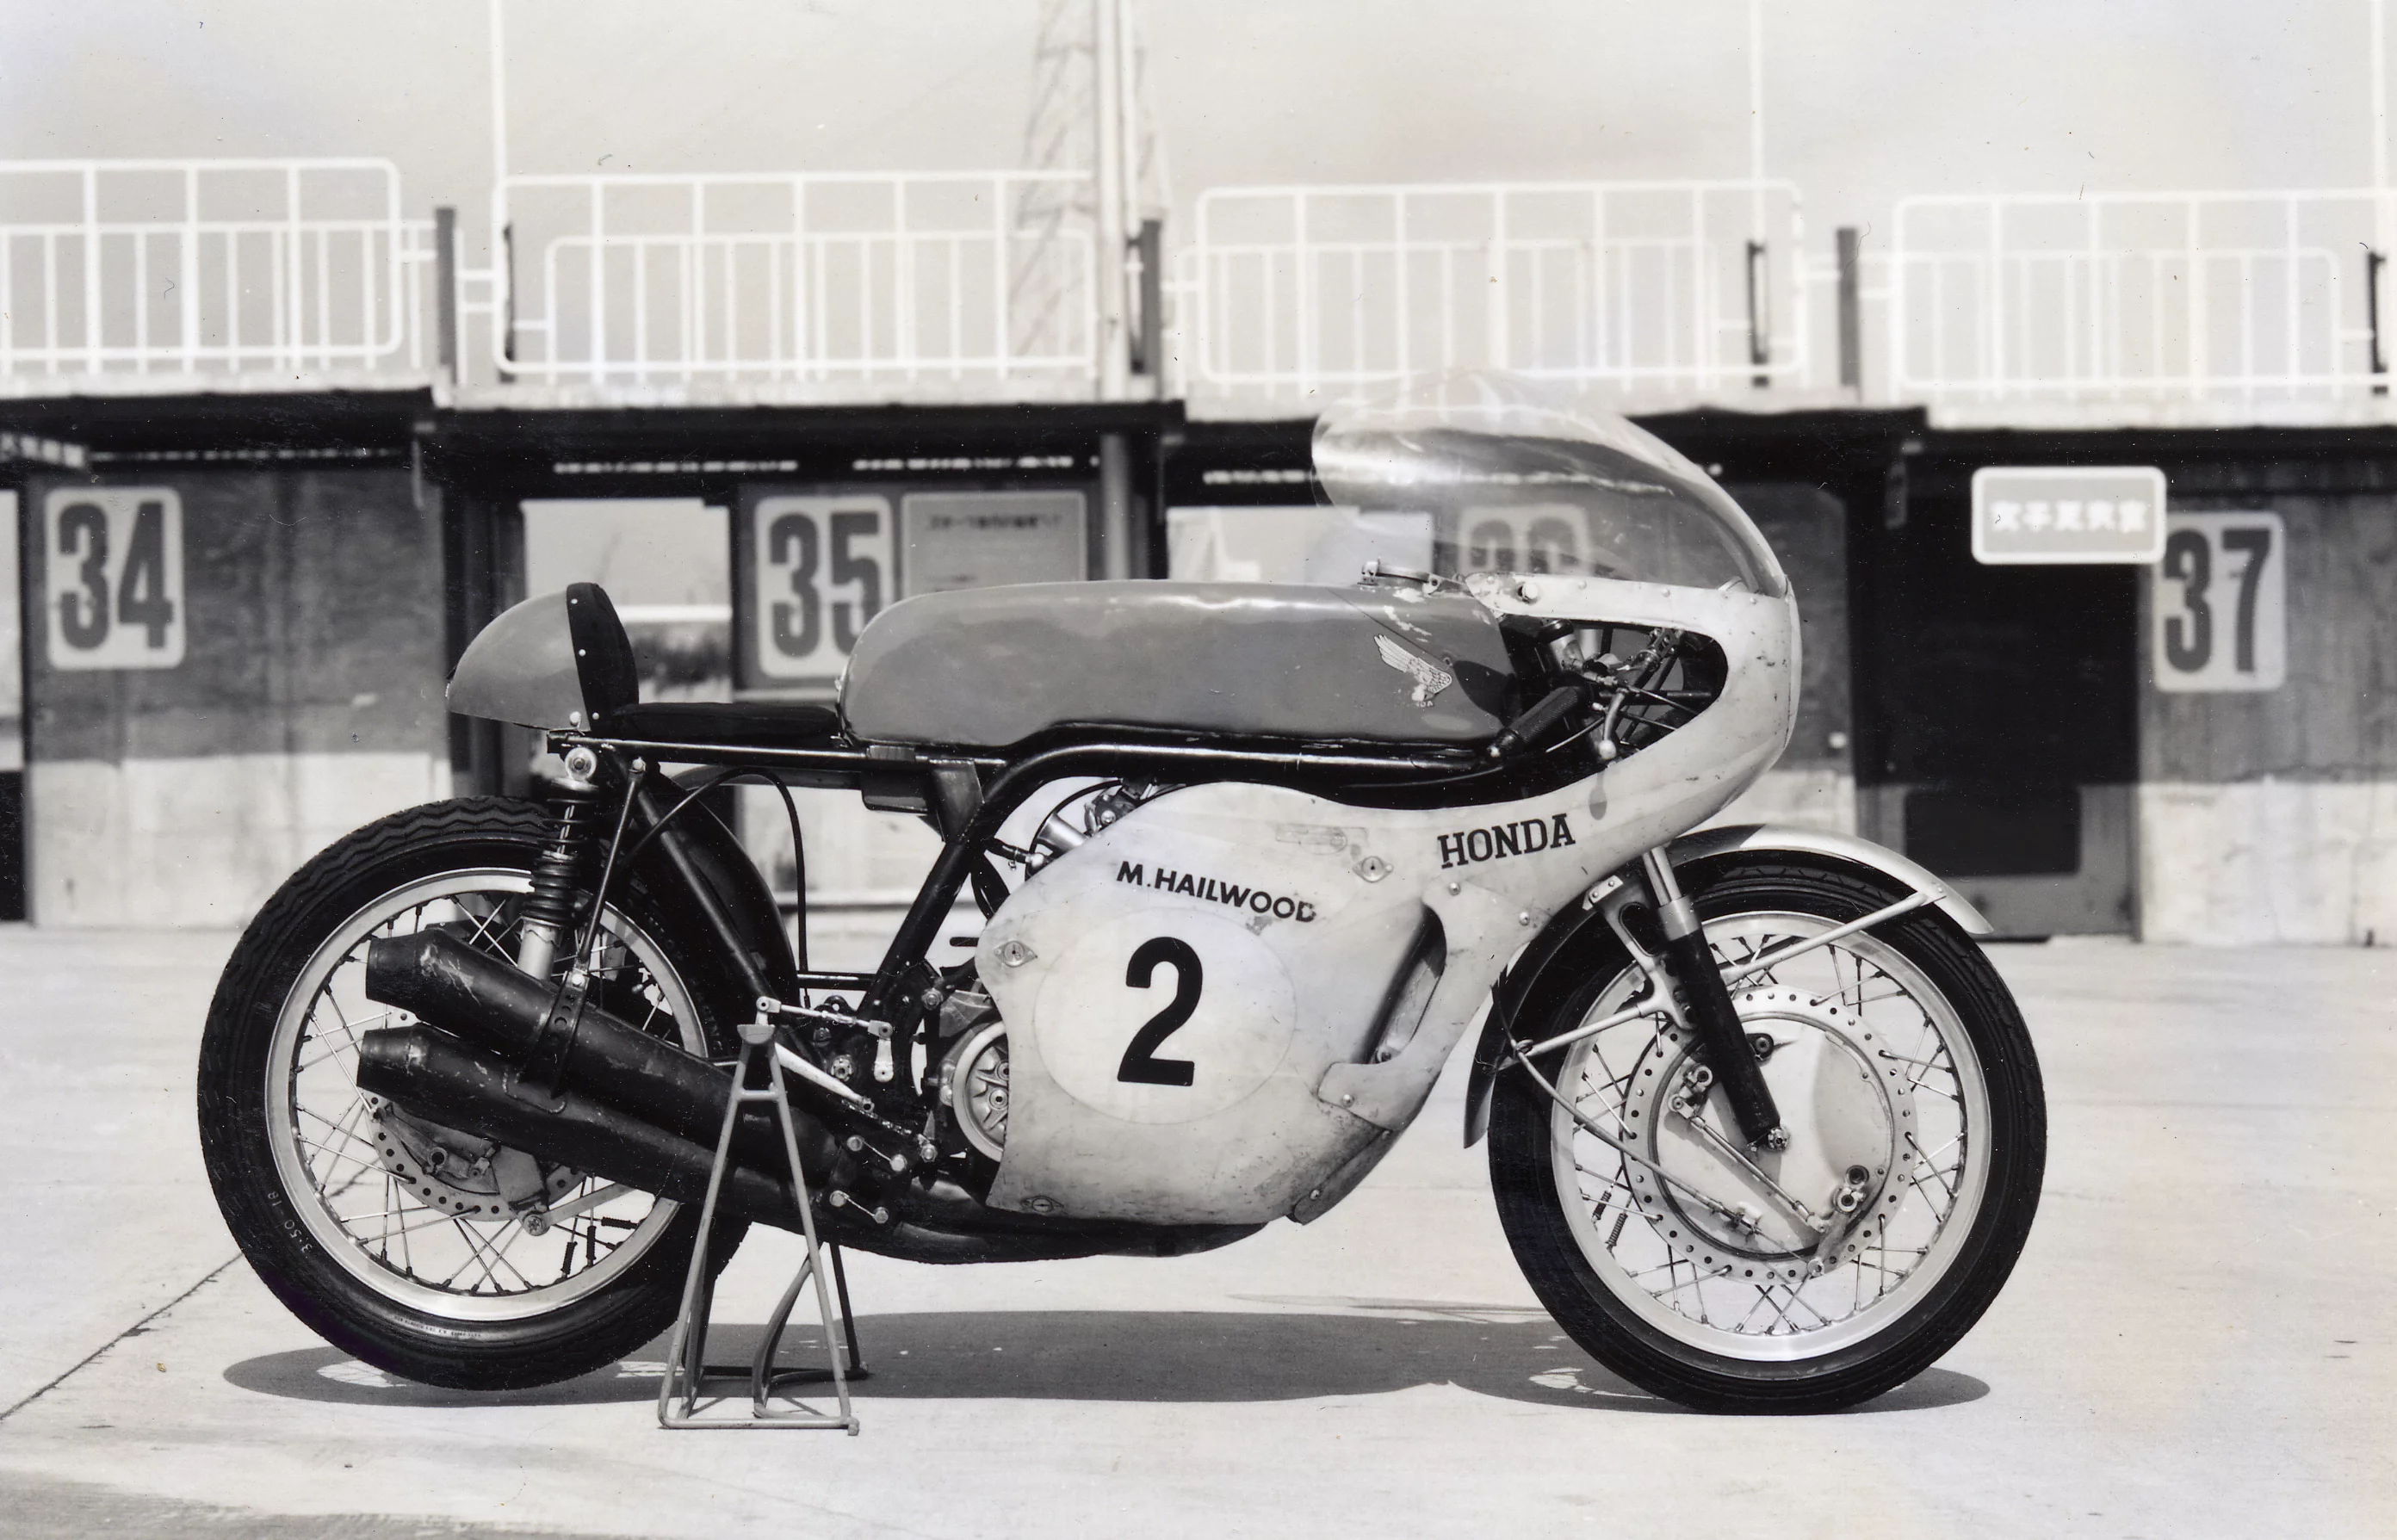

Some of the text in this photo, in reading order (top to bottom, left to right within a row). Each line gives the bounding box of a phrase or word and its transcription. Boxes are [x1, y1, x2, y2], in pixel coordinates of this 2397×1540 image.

[59, 502, 173, 650] 34
[771, 511, 881, 659] 35
[2165, 529, 2271, 672] 37
[1437, 813, 1576, 869] HONDA
[1117, 936, 1204, 1086] 2
